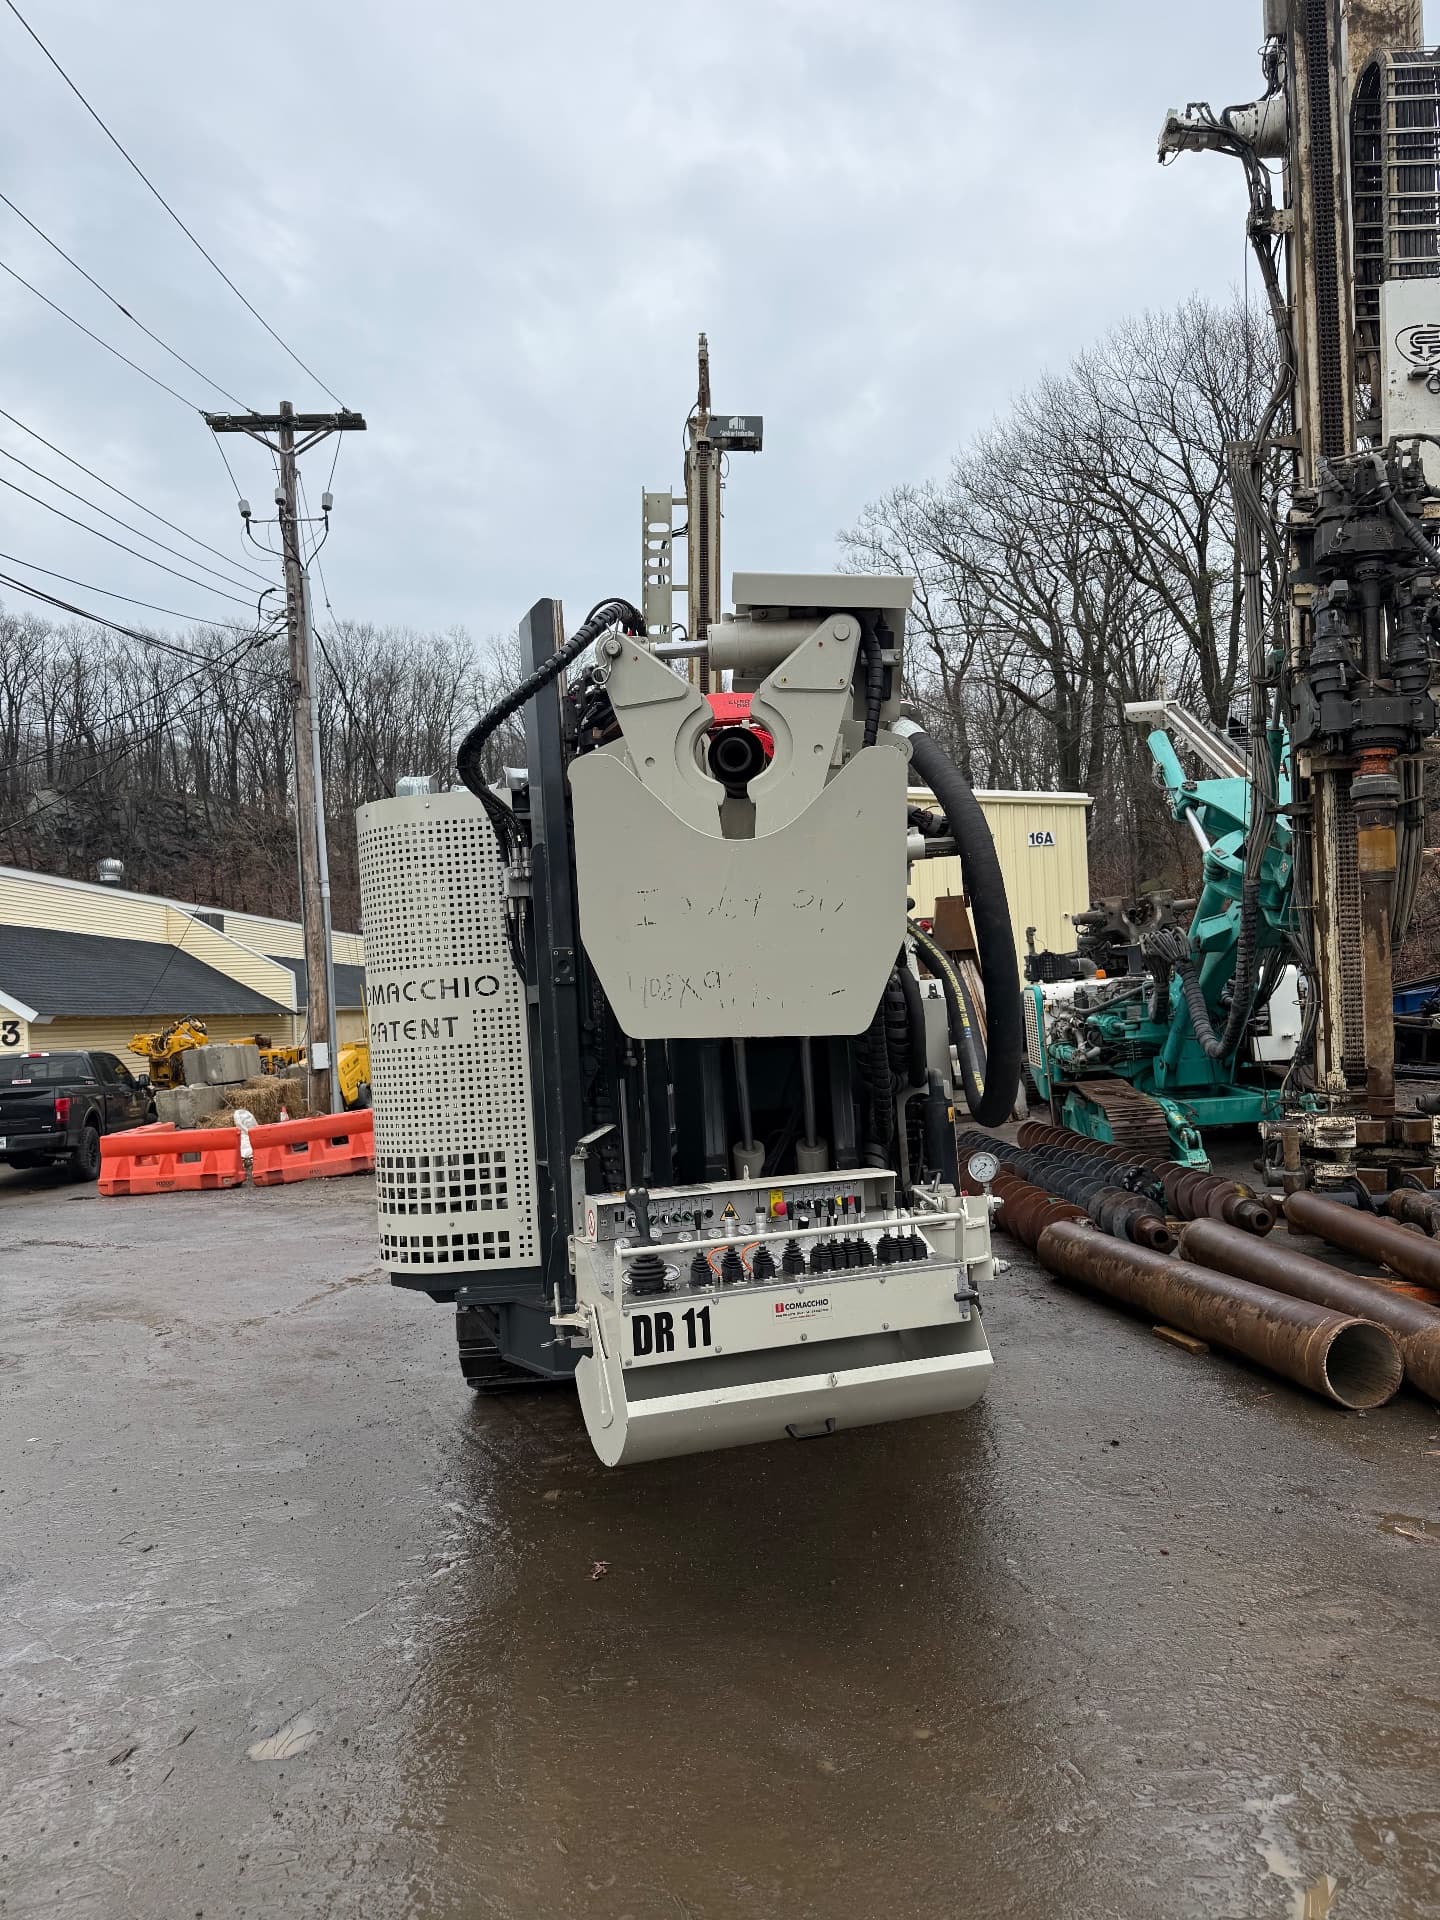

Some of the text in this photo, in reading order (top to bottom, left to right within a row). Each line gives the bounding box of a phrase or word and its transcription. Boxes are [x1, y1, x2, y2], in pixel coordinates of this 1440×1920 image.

[1029, 832, 1053, 844] 16A
[2, 1020, 21, 1047] 3
[371, 1016, 459, 1043] PATENT
[784, 1298, 829, 1311] COMACCHIO
[632, 1305, 712, 1357] DR 11
